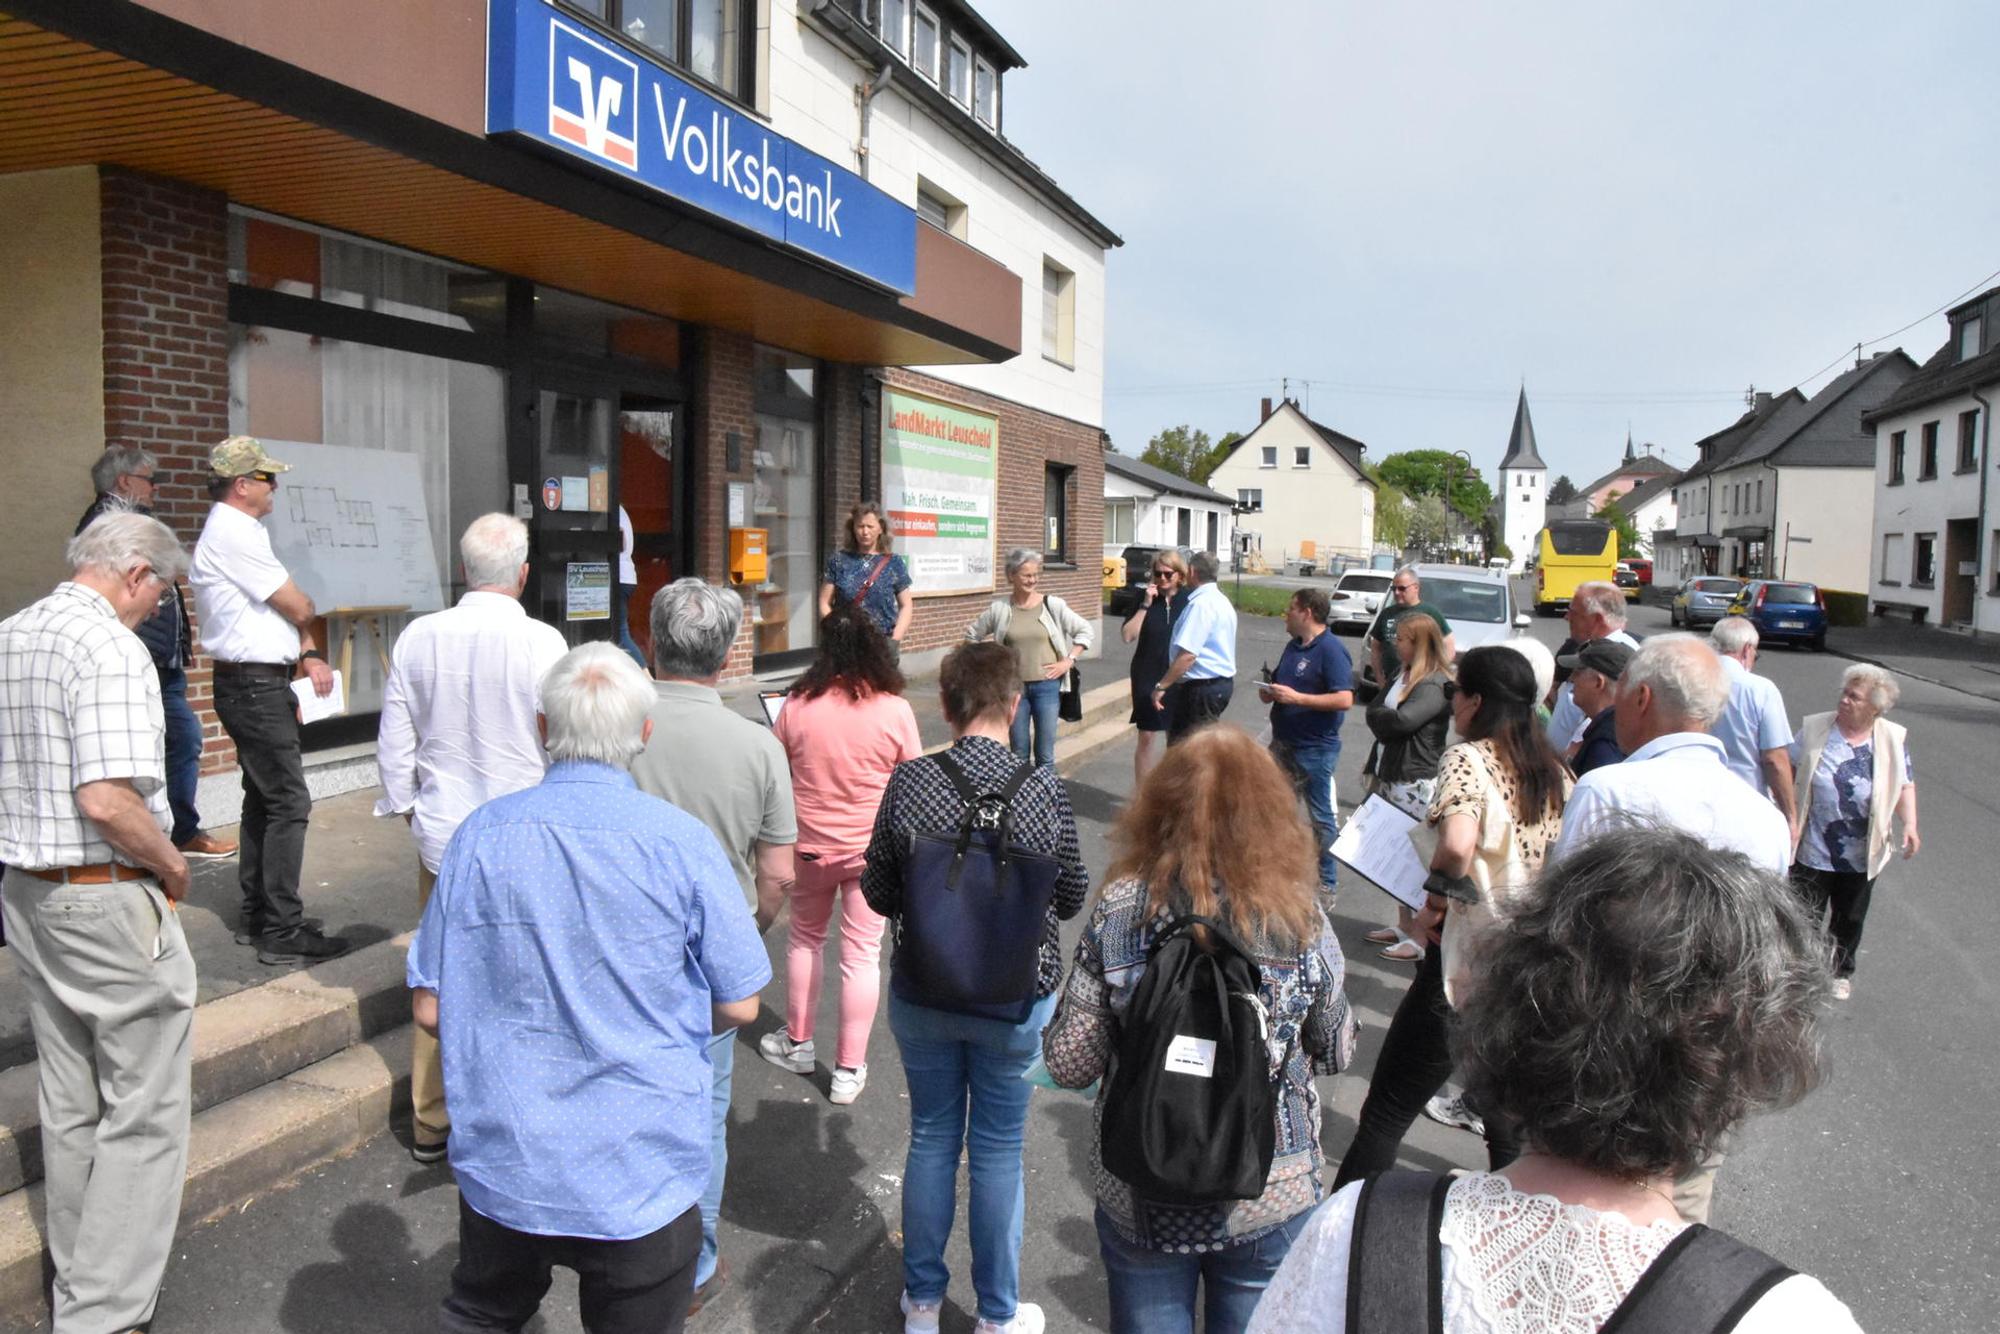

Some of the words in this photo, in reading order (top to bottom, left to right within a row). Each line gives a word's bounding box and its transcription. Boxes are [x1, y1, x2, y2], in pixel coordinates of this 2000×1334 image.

[653, 82, 842, 239] Volksbank
[888, 404, 946, 440] LandMarkt
[948, 419, 992, 448] Leuscheid
